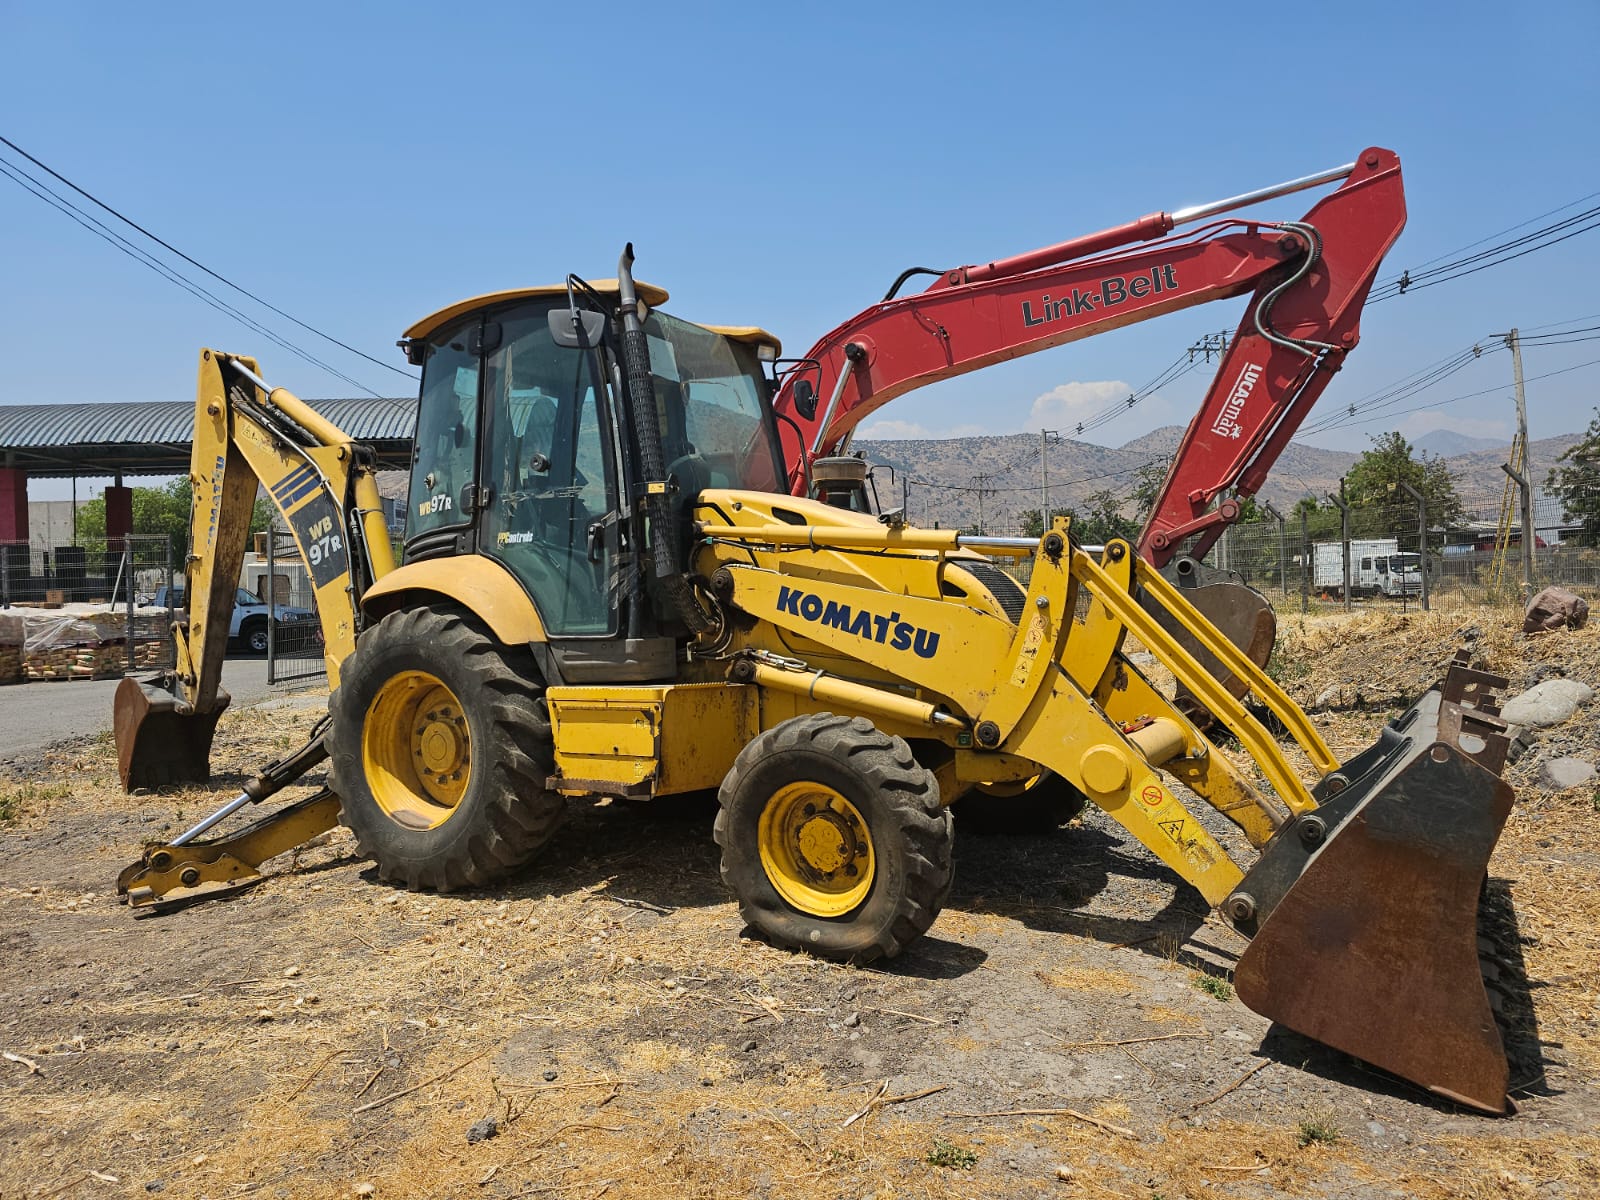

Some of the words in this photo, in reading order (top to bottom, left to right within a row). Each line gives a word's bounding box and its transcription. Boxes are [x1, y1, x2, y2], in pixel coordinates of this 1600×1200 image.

[1022, 264, 1178, 327] Link-Belt
[308, 516, 333, 541] WB
[309, 535, 343, 566] 97R
[776, 585, 941, 659] KOMATSU
